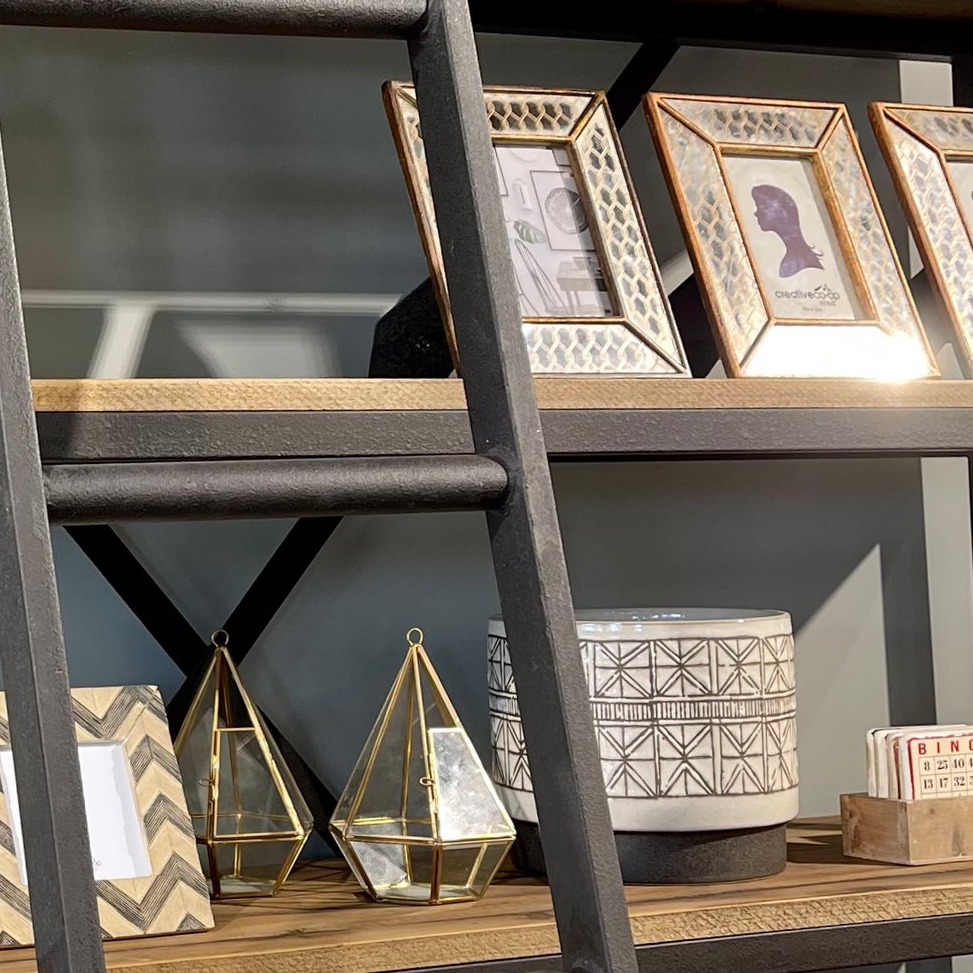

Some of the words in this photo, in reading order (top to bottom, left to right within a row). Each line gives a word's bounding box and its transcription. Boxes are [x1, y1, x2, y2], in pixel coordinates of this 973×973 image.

[924, 761, 930, 771] 8
[937, 759, 948, 770] 25
[924, 779, 933, 789] 13
[939, 777, 948, 788] 17
[953, 776, 965, 787] 32
